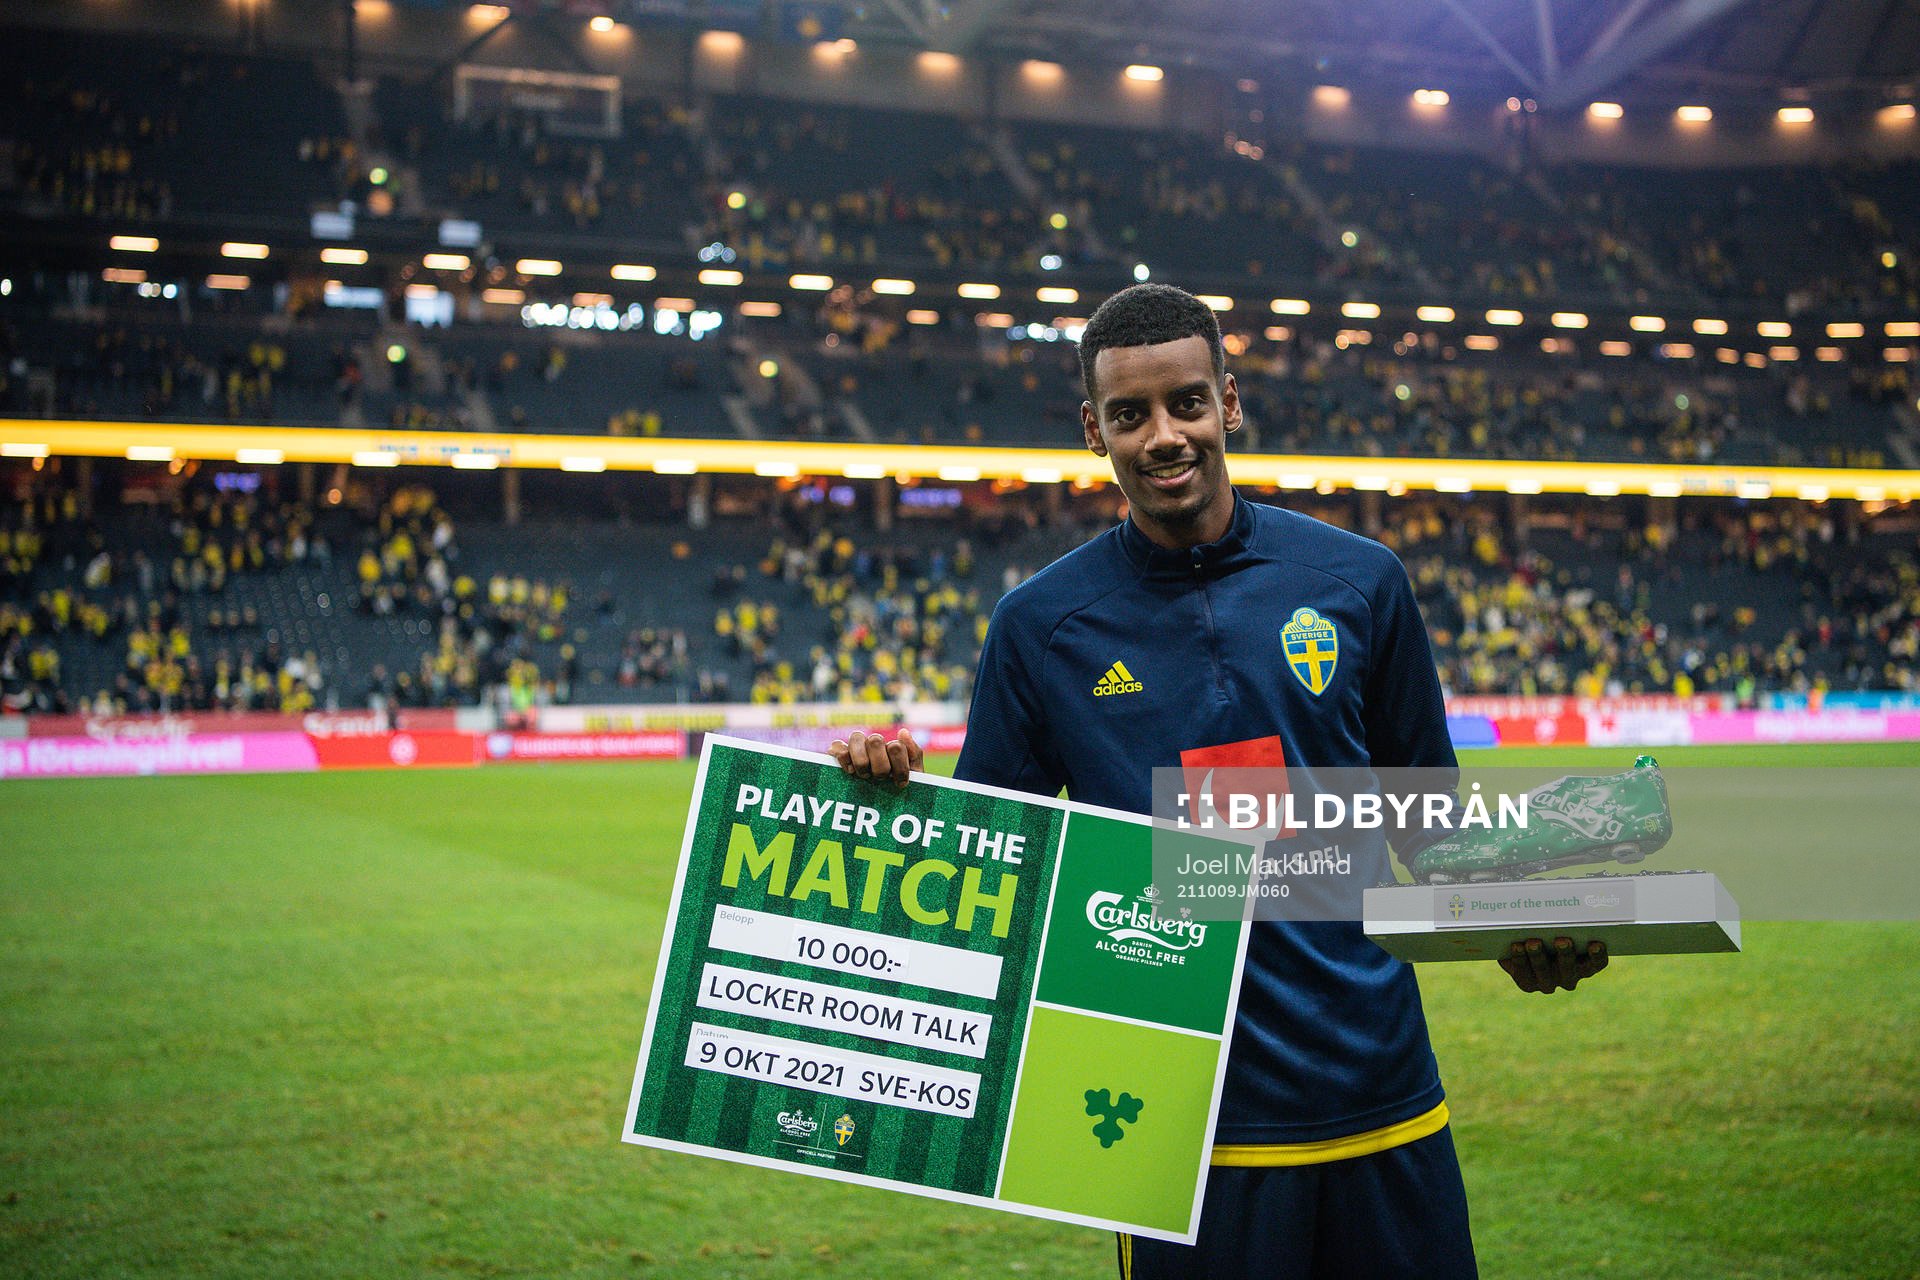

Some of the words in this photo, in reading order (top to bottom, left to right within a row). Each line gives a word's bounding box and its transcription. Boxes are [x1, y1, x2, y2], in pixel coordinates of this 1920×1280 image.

[1290, 631, 1329, 641] SVERIGE
[1092, 680, 1143, 697] adidas
[735, 783, 880, 838] PLAYER
[891, 813, 945, 848] OF
[956, 824, 1026, 864] THE
[720, 822, 1019, 938] MATCH
[1470, 900, 1507, 912] Player
[1510, 898, 1521, 909] of
[1523, 898, 1541, 908] the
[1544, 896, 1580, 908] match
[719, 910, 755, 926] Belopp
[1086, 890, 1208, 948] Carlsberg
[797, 936, 825, 960] 10
[1095, 940, 1153, 959] ALCOHOL
[1156, 952, 1186, 965] FREE
[709, 975, 814, 1015] LOCKER
[821, 997, 904, 1031] ROOM
[911, 1011, 980, 1046] TALK
[699, 1041, 717, 1064] 9
[724, 1046, 781, 1075] OKT
[784, 1057, 844, 1087] 2021
[858, 1070, 972, 1110] SVE-KOS
[777, 1111, 817, 1131] Carlsberg
